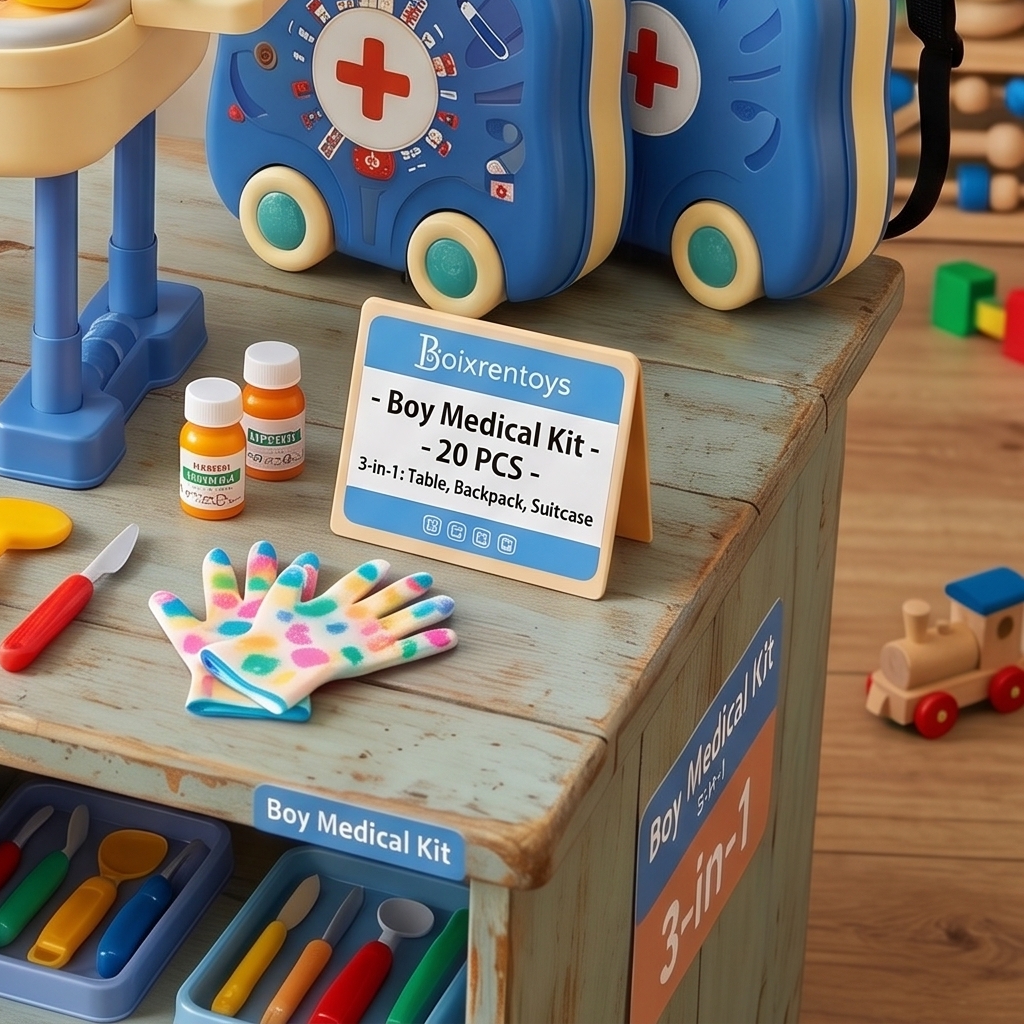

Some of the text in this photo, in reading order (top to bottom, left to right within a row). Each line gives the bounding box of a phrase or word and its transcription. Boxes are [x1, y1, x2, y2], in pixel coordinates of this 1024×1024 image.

[414, 333, 571, 398] Boixrentoys
[387, 389, 435, 427] Boy
[440, 401, 541, 447] Medical
[547, 426, 585, 458] Kit
[358, 456, 594, 527] 3-in-1: Table, Backpack, Suitcase
[435, 438, 468, 467] 20
[475, 447, 524, 480] PCS
[649, 635, 775, 864] Boy Medical Kit
[267, 797, 451, 865] Boy Medical Kit
[659, 777, 751, 986] 3-in-1
